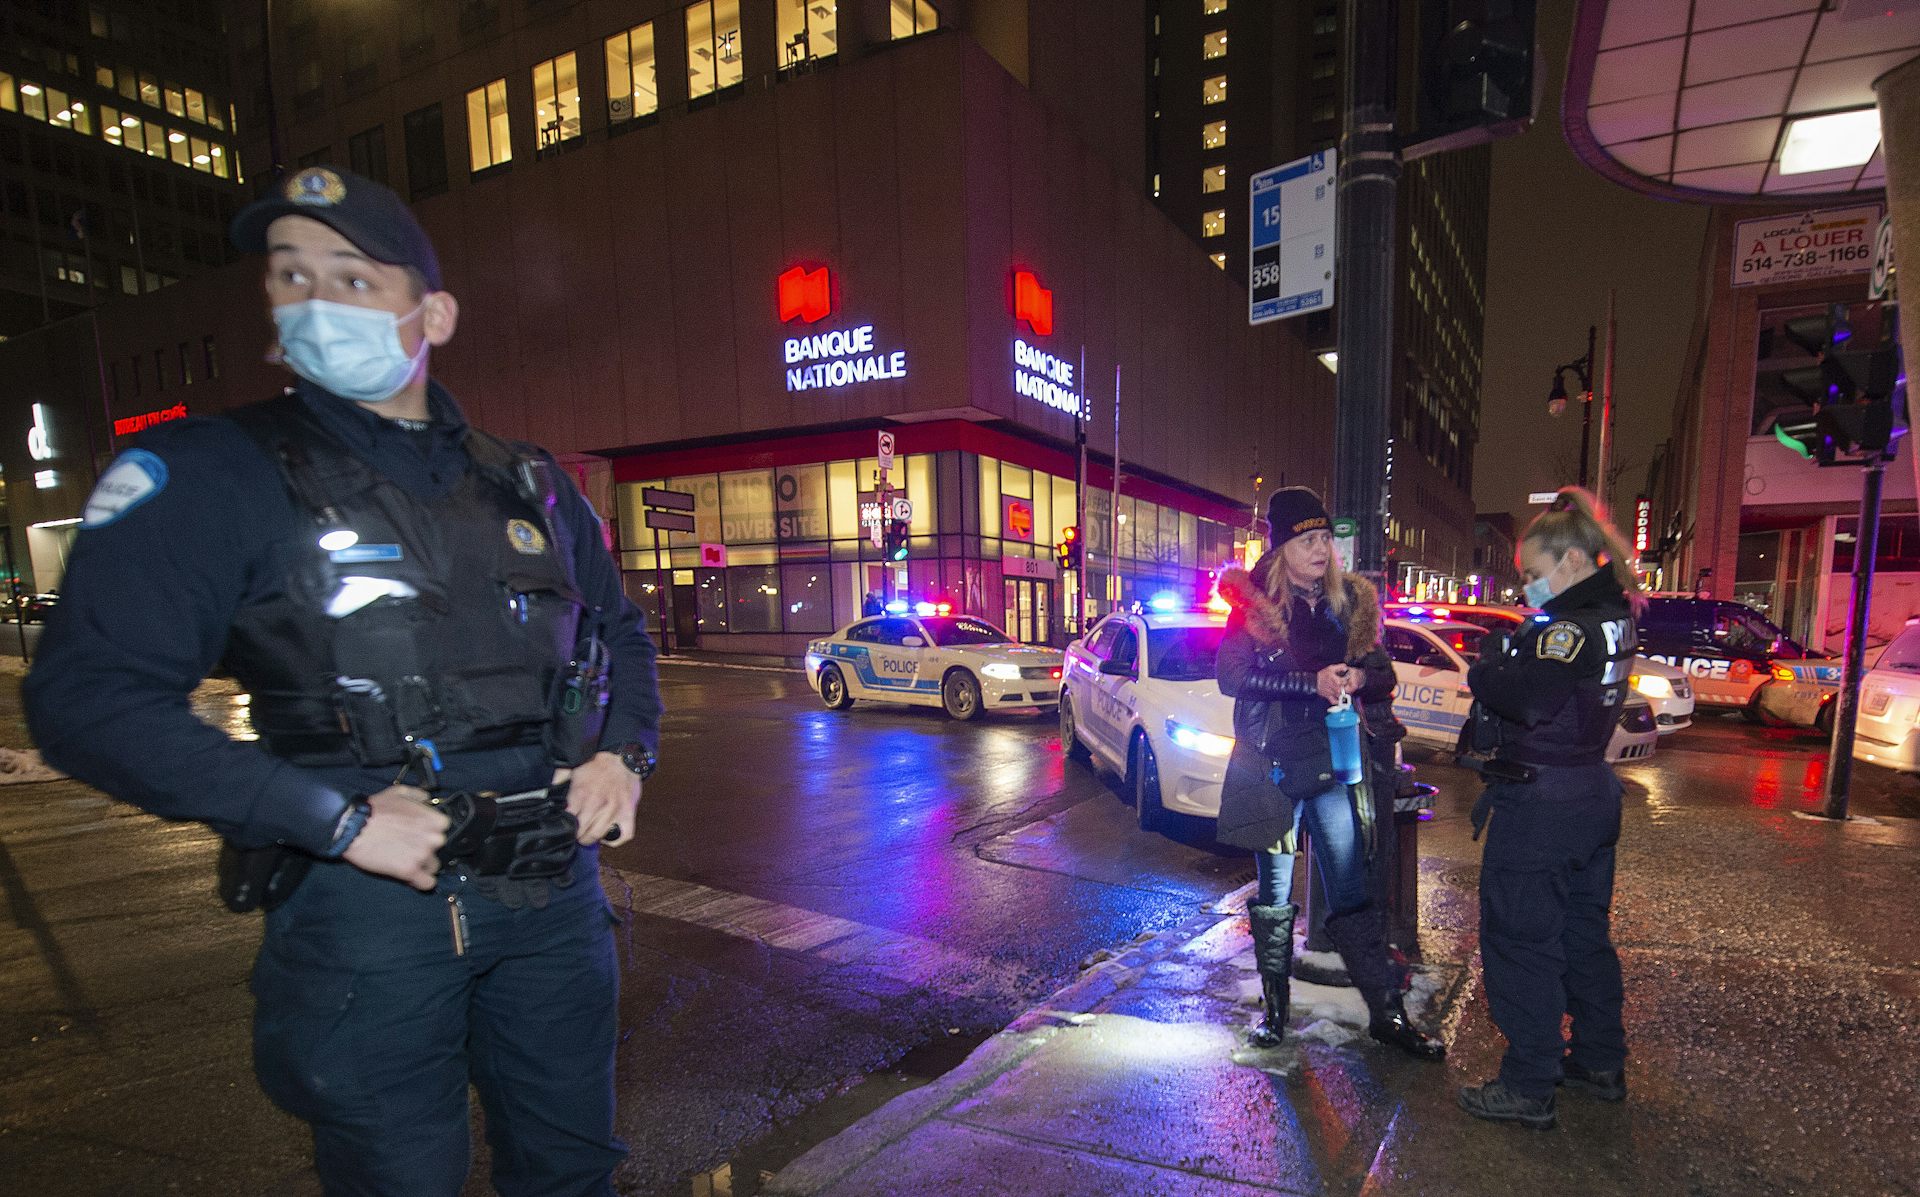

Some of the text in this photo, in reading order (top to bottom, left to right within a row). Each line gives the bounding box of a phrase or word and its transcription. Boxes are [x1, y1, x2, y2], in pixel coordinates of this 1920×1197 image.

[1262, 204, 1280, 228] 15
[1763, 227, 1807, 239] LOCAL
[1780, 229, 1864, 252] LOUER
[1742, 244, 1870, 273] 514-738-1166
[1253, 264, 1280, 290] 358
[784, 324, 874, 364] BANQUE
[786, 351, 907, 392] NATIONALE
[1014, 338, 1074, 387] BANQUE
[1026, 561, 1039, 574] 801
[883, 659, 919, 674] POLICE
[1393, 683, 1445, 706] OLICE
